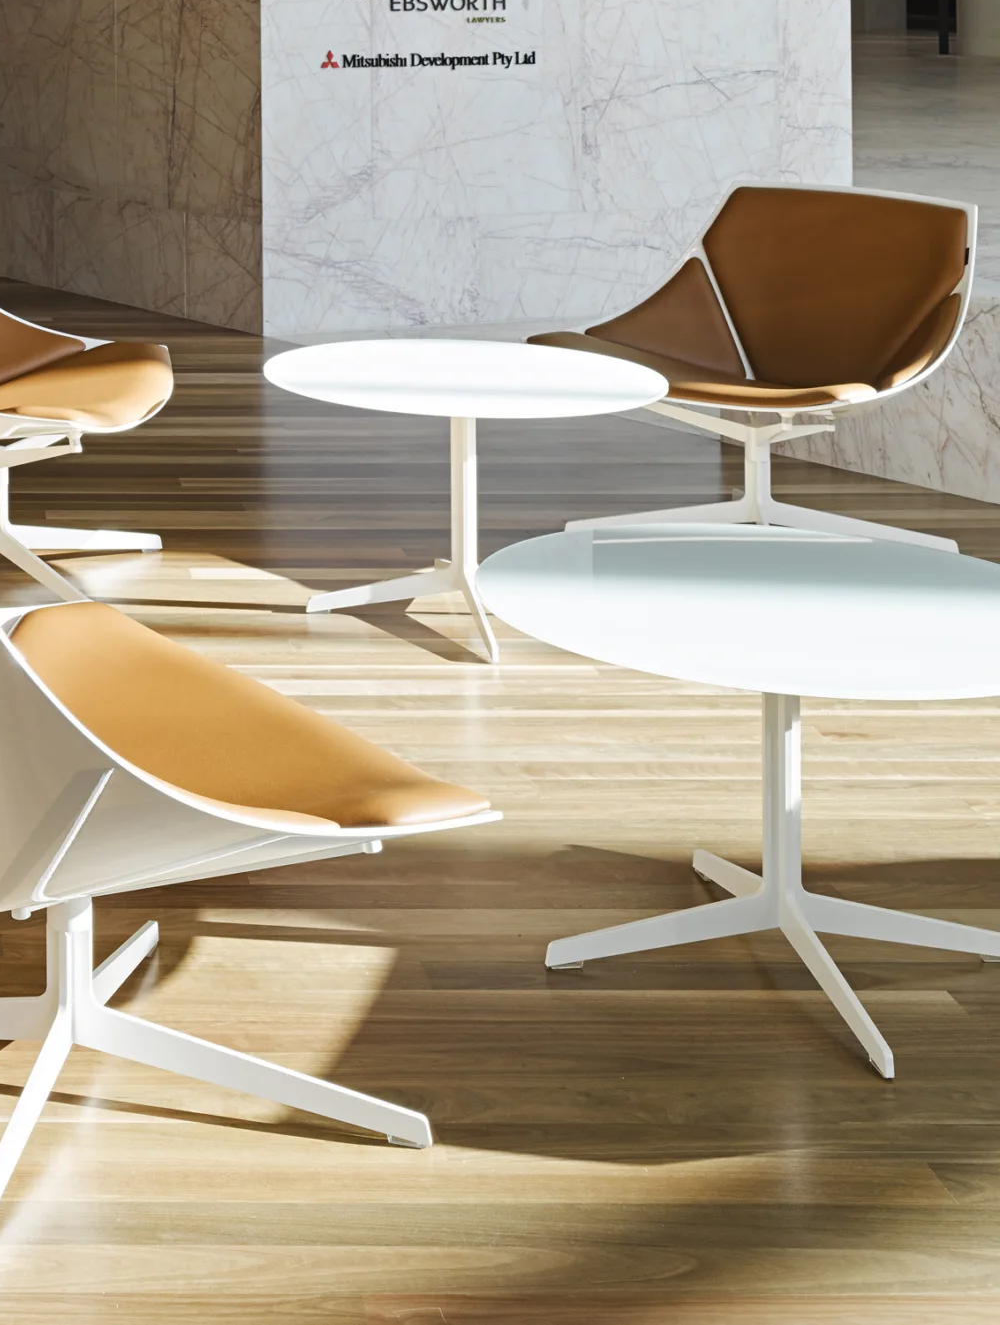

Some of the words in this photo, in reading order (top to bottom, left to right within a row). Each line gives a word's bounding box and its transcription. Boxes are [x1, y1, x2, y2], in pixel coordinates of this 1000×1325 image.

[342, 53, 407, 68] Mitsubishi
[411, 52, 489, 70] Development
[492, 52, 513, 69] Pty
[515, 51, 536, 65] Ltd
